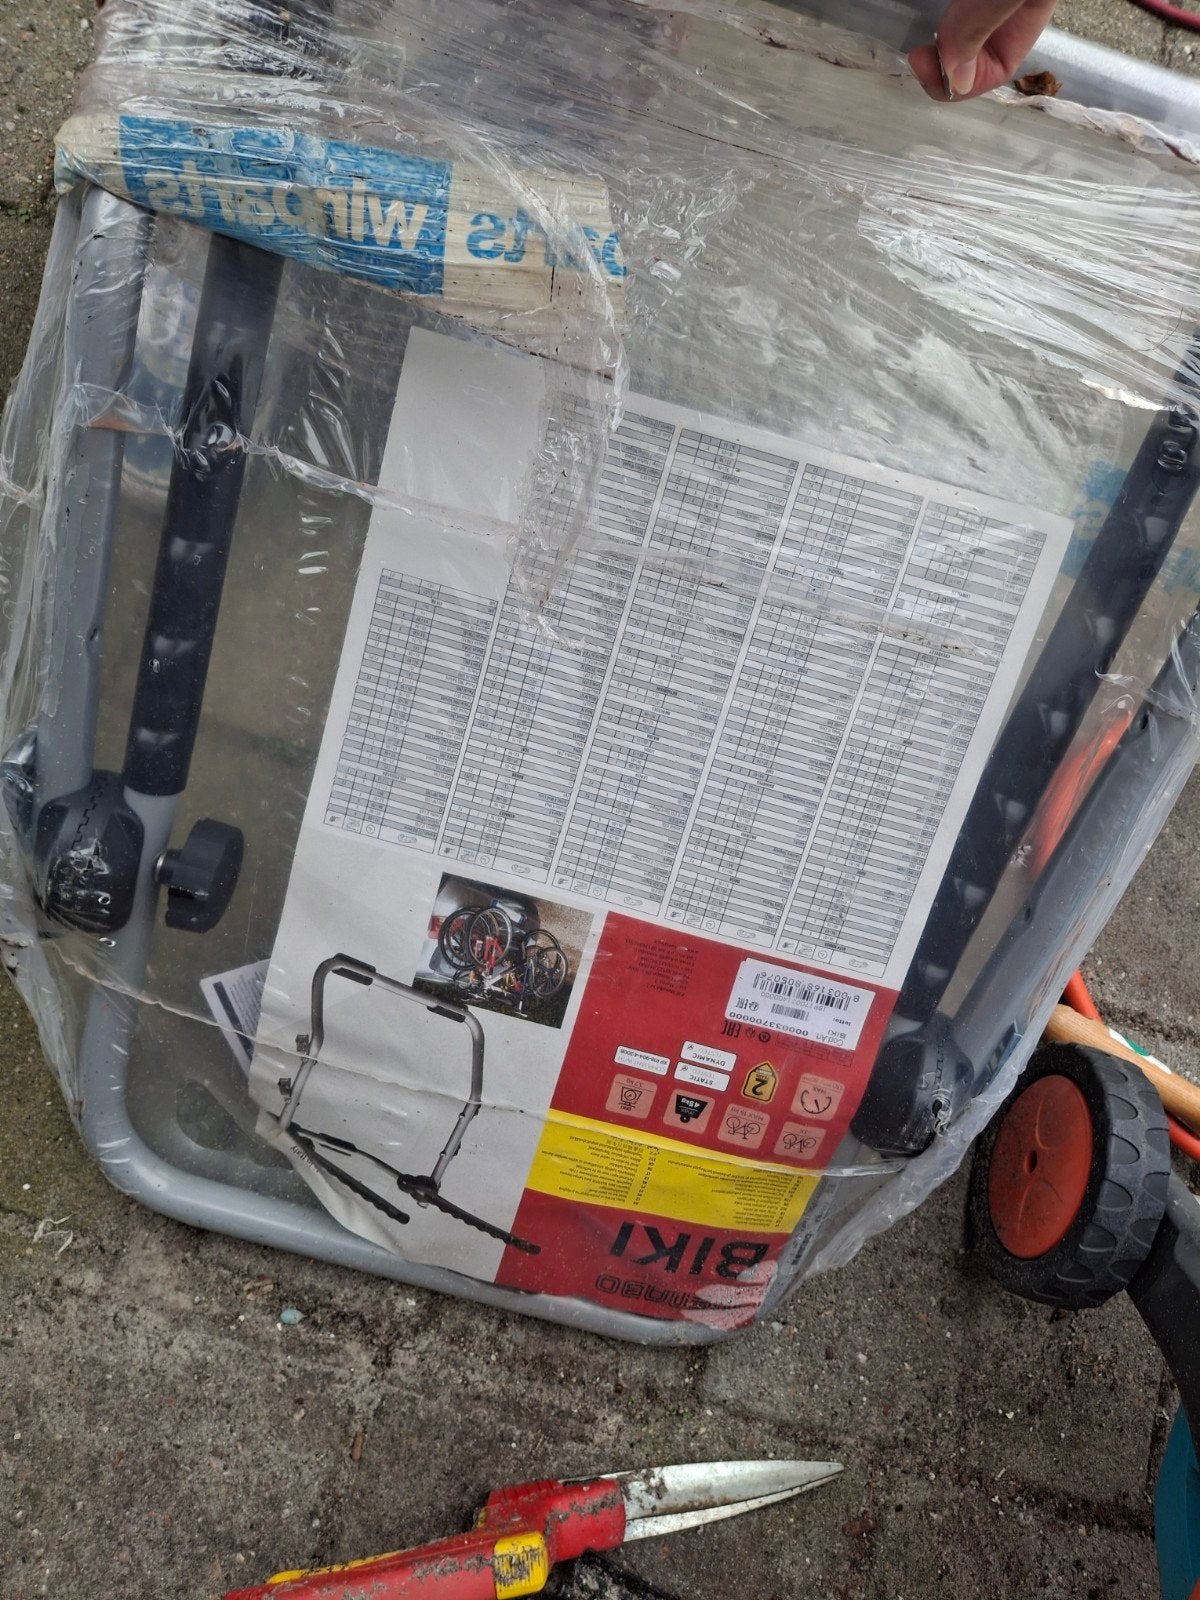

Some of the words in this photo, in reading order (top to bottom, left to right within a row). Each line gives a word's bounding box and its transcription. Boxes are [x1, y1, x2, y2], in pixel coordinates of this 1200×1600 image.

[759, 971, 804, 987] 805076
[806, 982, 848, 1001] 003168
[852, 995, 860, 1003] 8
[729, 1011, 809, 1037] 000033700000
[828, 1029, 848, 1040] BIKI
[690, 1052, 726, 1067] DYNAMIC
[688, 1073, 714, 1085] STATIC
[750, 1076, 768, 1097] 2
[679, 1096, 701, 1109] 45kg
[747, 1111, 764, 1121] MAX
[610, 1221, 770, 1279] BIKI
